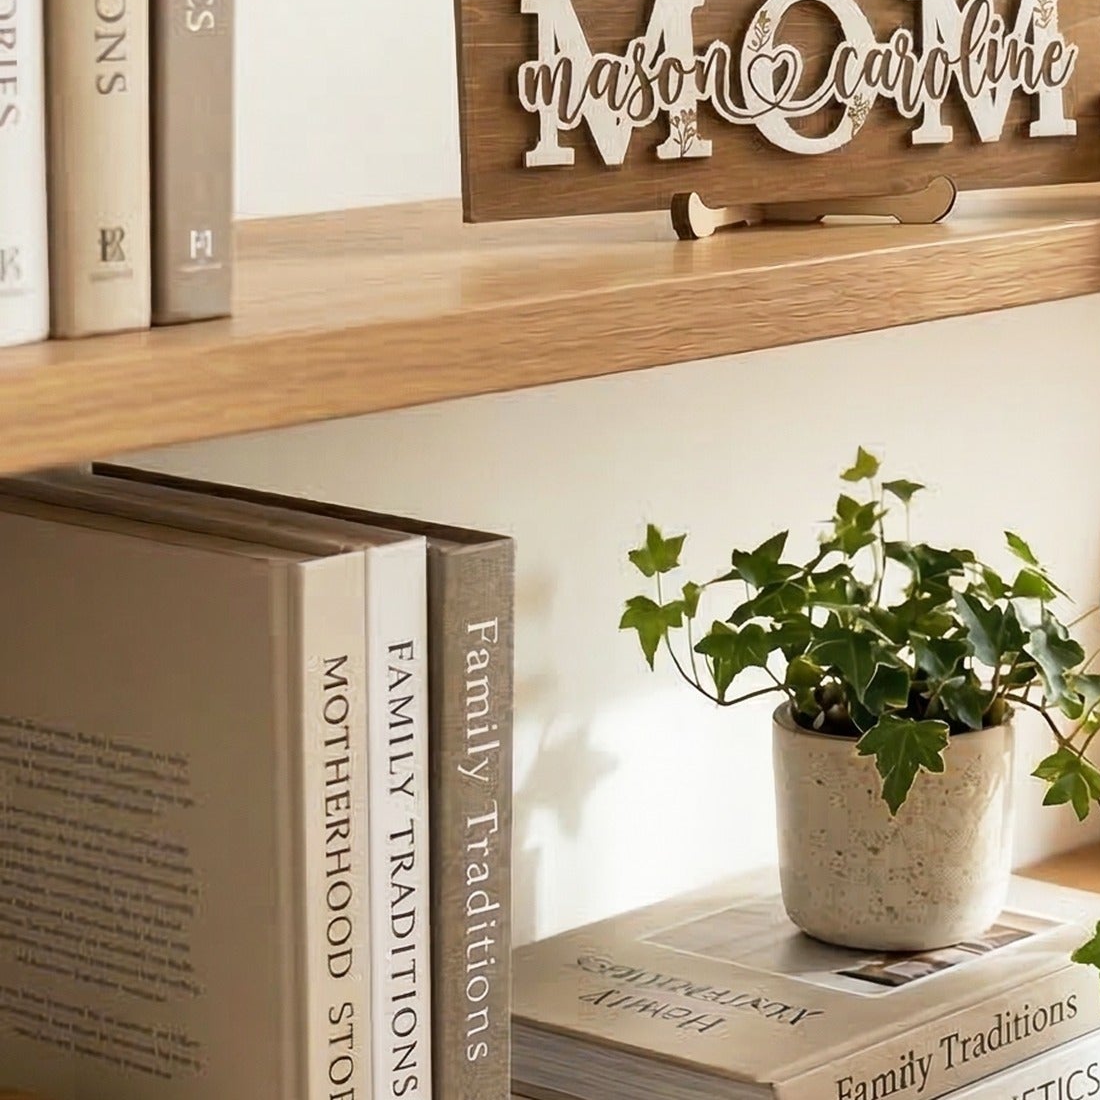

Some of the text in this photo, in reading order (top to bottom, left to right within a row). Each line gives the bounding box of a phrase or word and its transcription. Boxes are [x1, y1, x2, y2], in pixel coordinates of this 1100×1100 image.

[525, 0, 1077, 122] mason caroline
[322, 654, 353, 980] MOTHERHOOD
[387, 639, 418, 1097] FAMILY TRADITIONS
[457, 616, 501, 1062] Family Traditions
[940, 994, 1078, 1071] Traditions
